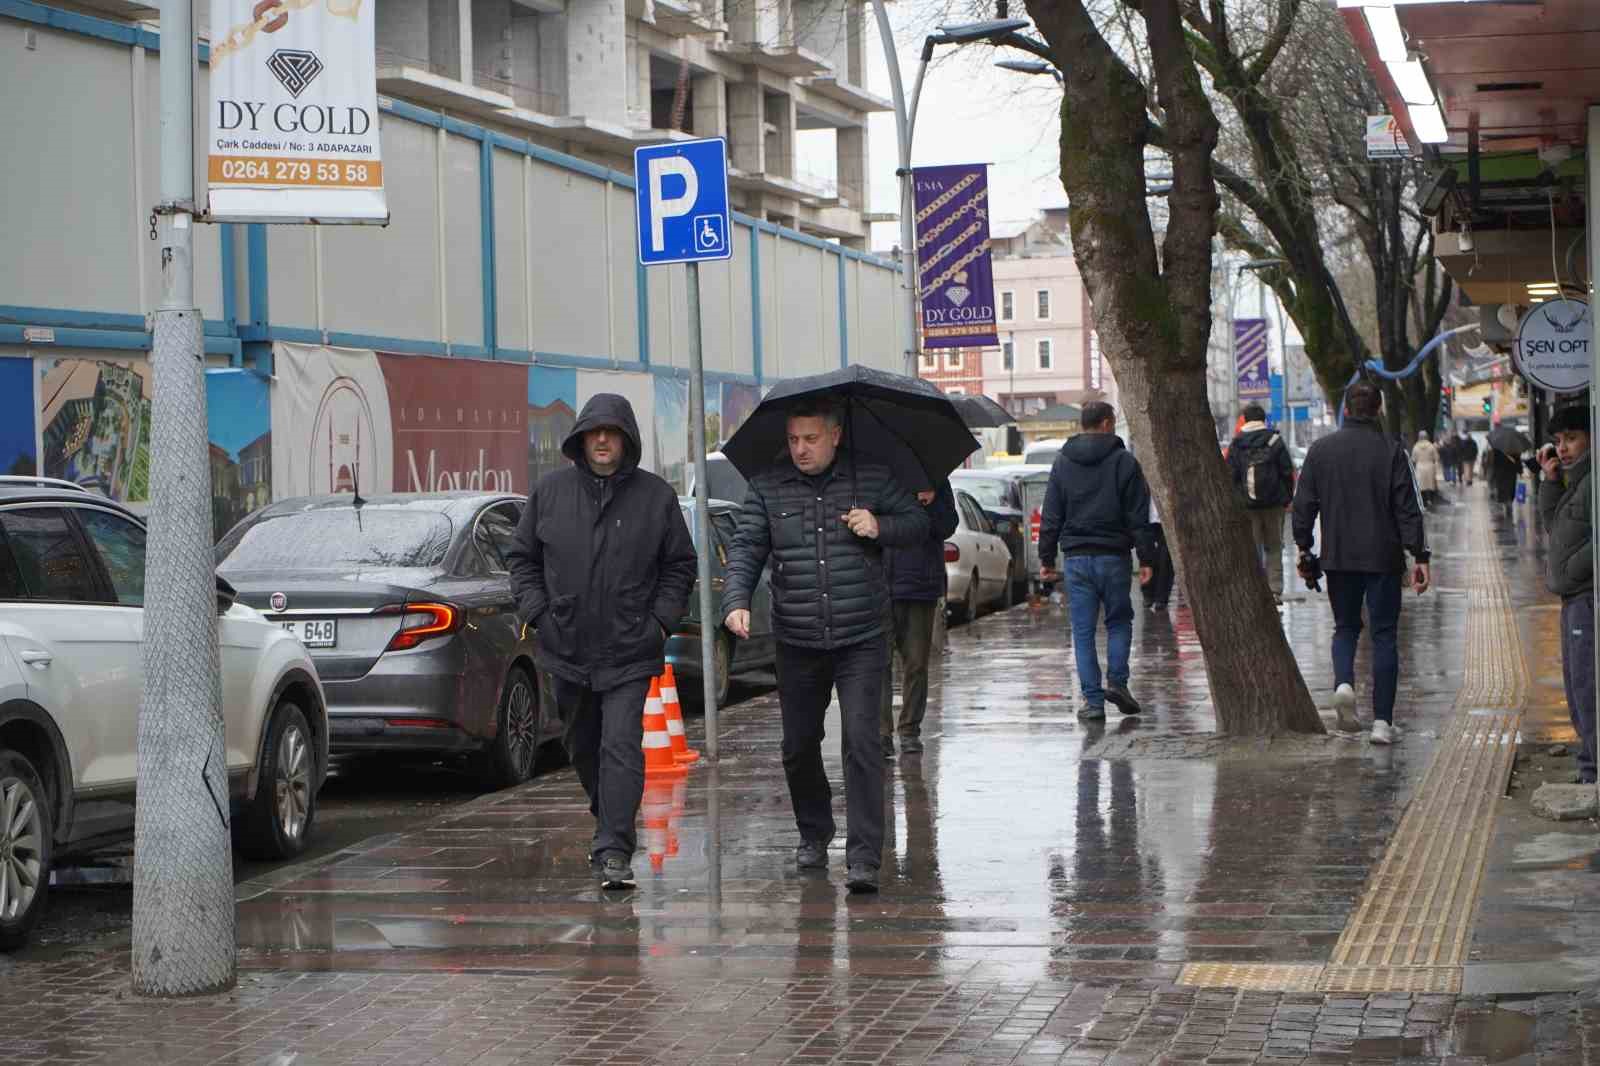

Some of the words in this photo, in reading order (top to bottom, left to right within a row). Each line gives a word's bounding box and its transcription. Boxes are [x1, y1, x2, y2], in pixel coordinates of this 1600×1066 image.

[217, 100, 265, 131] DY
[273, 103, 370, 135] GOLD
[217, 139, 239, 150] Çark
[242, 140, 281, 151] Caddesi
[289, 142, 306, 151] No:
[308, 143, 314, 151] 3
[317, 143, 372, 153] ADAPAZARI
[222, 159, 270, 179] 0264
[276, 162, 311, 180] 279
[317, 164, 339, 180] 53
[346, 165, 368, 181] 58
[648, 156, 698, 251] P
[926, 308, 946, 322] DY
[949, 306, 992, 321] GOLD
[1526, 340, 1555, 357] ŞEN
[305, 622, 333, 640] 648
